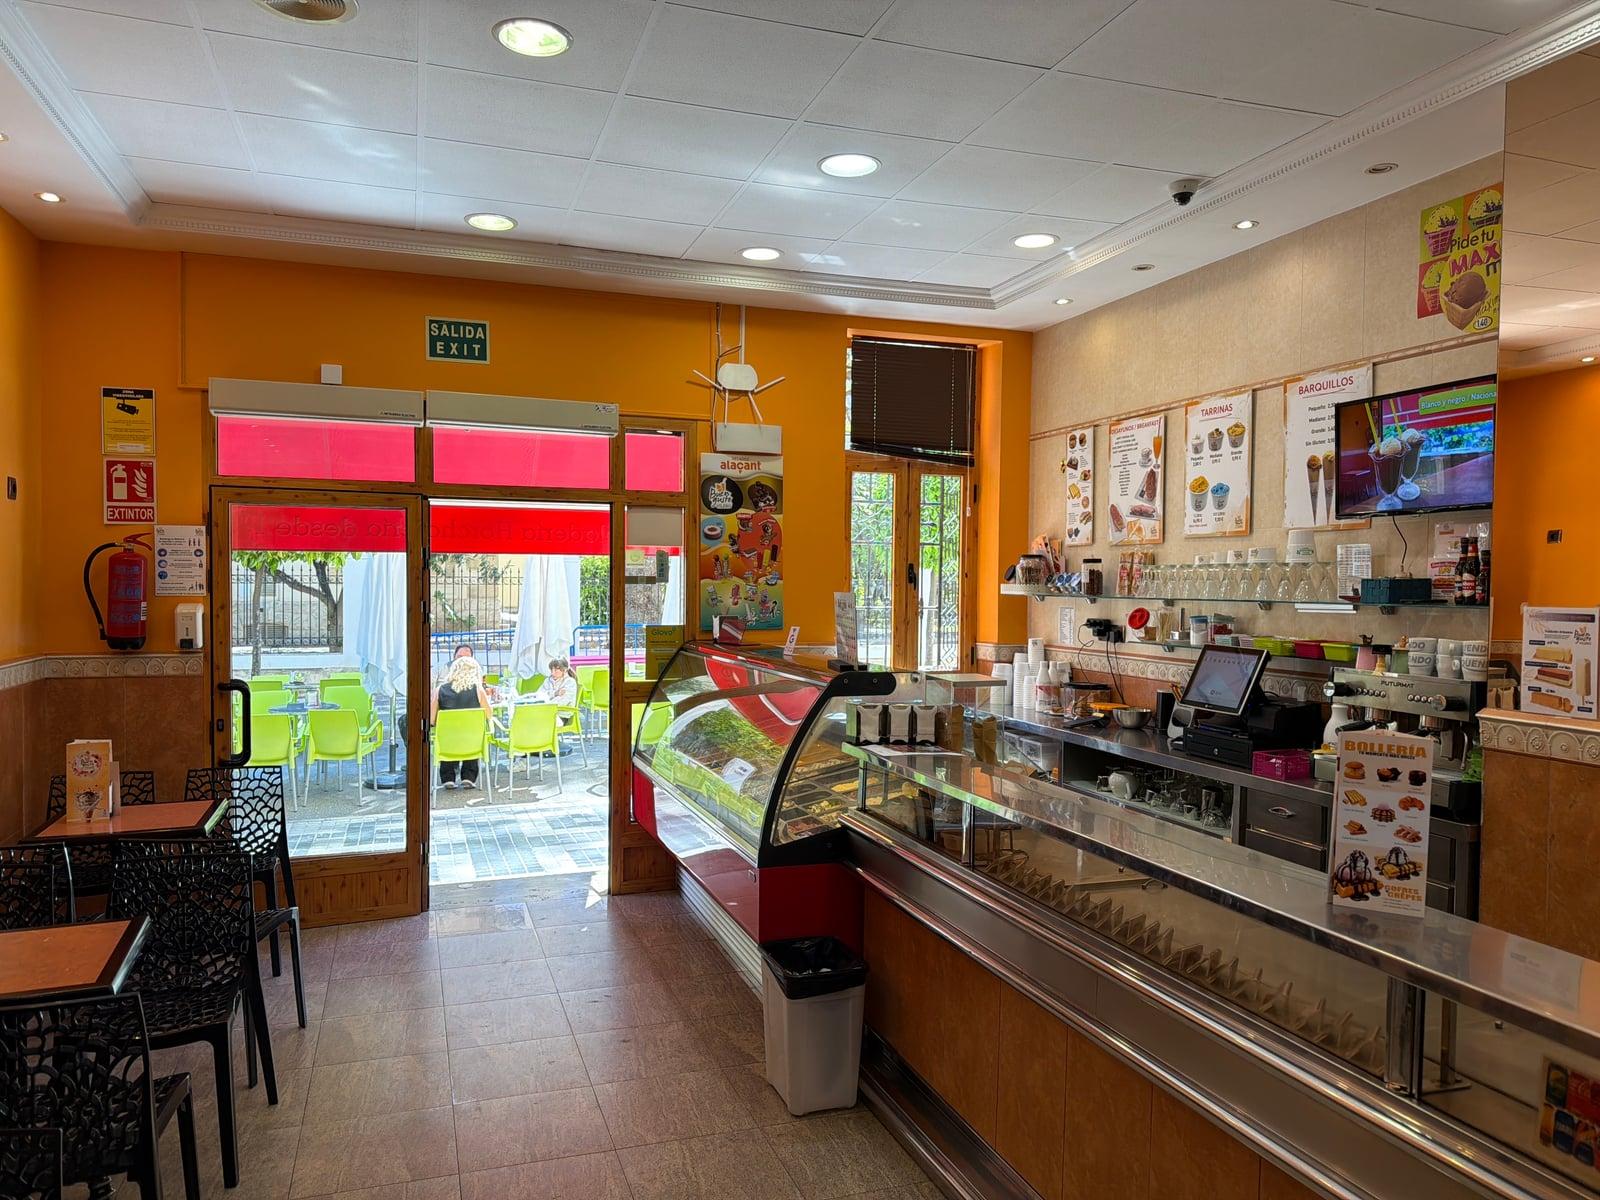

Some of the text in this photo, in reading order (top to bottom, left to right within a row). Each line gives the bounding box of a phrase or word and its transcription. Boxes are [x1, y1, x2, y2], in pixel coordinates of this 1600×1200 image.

[1450, 233, 1479, 253] Pide
[1481, 229, 1494, 243] tu
[1449, 240, 1501, 277] MAX
[430, 321, 485, 340] SALIDA
[435, 341, 481, 357] EXIT
[1298, 375, 1354, 395] BARQUILLOS
[1200, 403, 1233, 417] TARRINAS
[1421, 400, 1441, 409] Blanco
[1447, 396, 1466, 405] negro
[720, 461, 761, 474] alaçant
[107, 508, 154, 520] EXTINTOR
[651, 627, 673, 637] Glovo
[1380, 680, 1414, 689] FUTURMAT
[1344, 740, 1427, 758] BOLLERÍA
